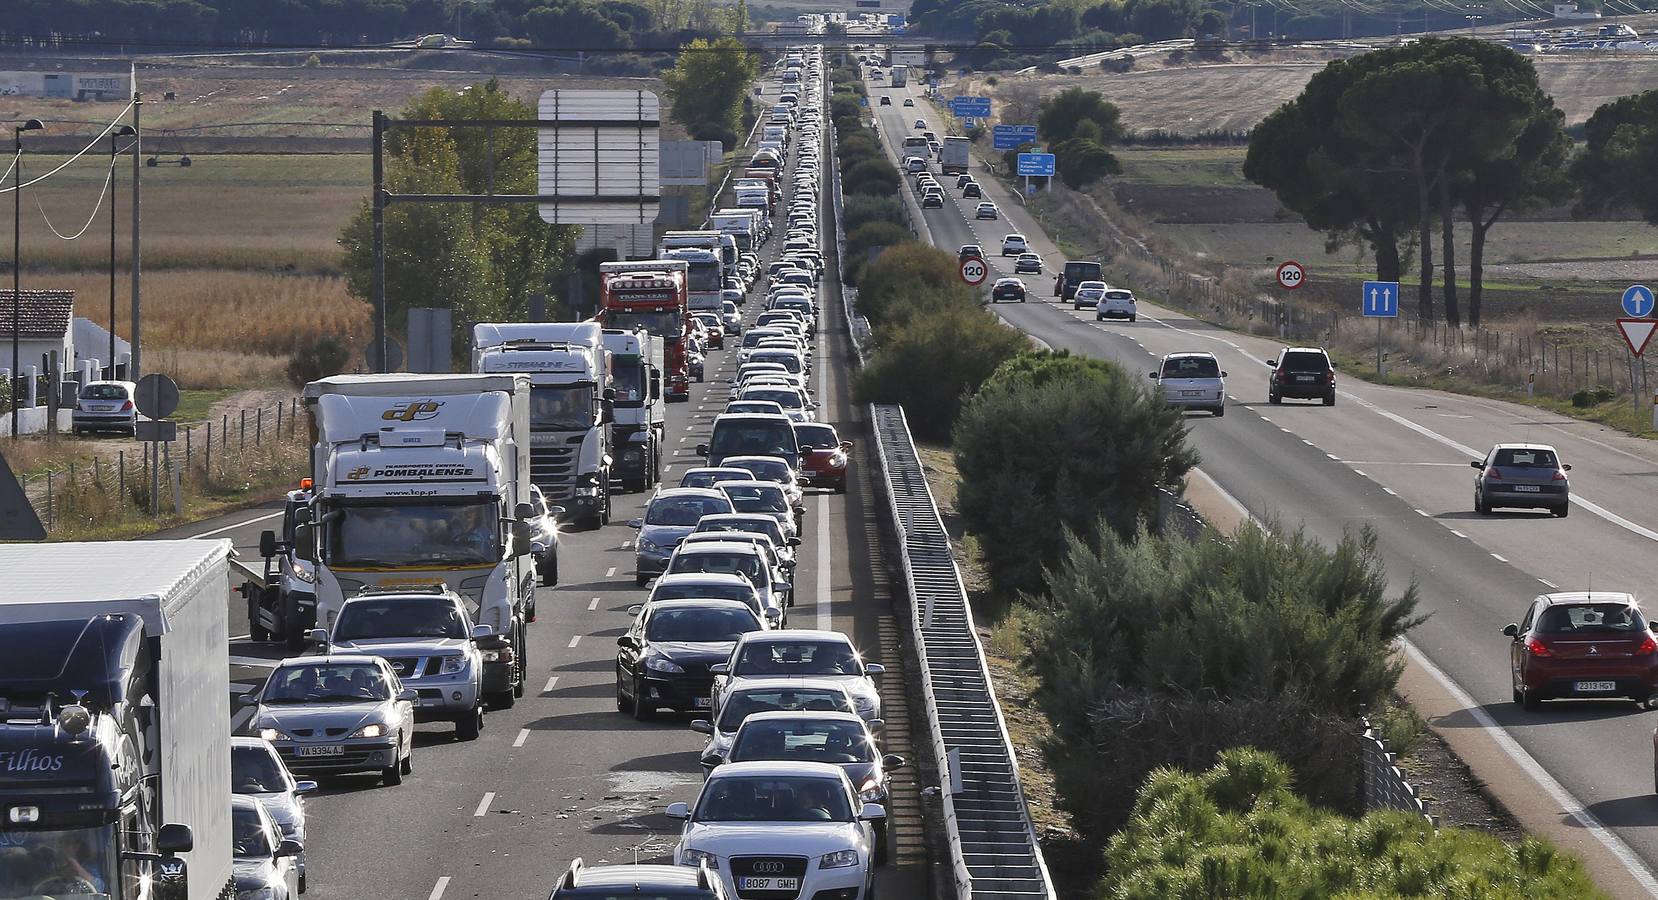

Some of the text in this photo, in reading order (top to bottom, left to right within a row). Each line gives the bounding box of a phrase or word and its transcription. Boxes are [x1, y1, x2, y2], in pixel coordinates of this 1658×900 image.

[964, 266, 983, 276] 120
[1281, 271, 1301, 280] 120
[374, 468, 474, 477] POMBALENSE
[385, 489, 438, 497] www.tcp.pt
[1579, 682, 1598, 690] 2313
[312, 746, 332, 755] 9394
[746, 879, 796, 889] 8087 GMH
